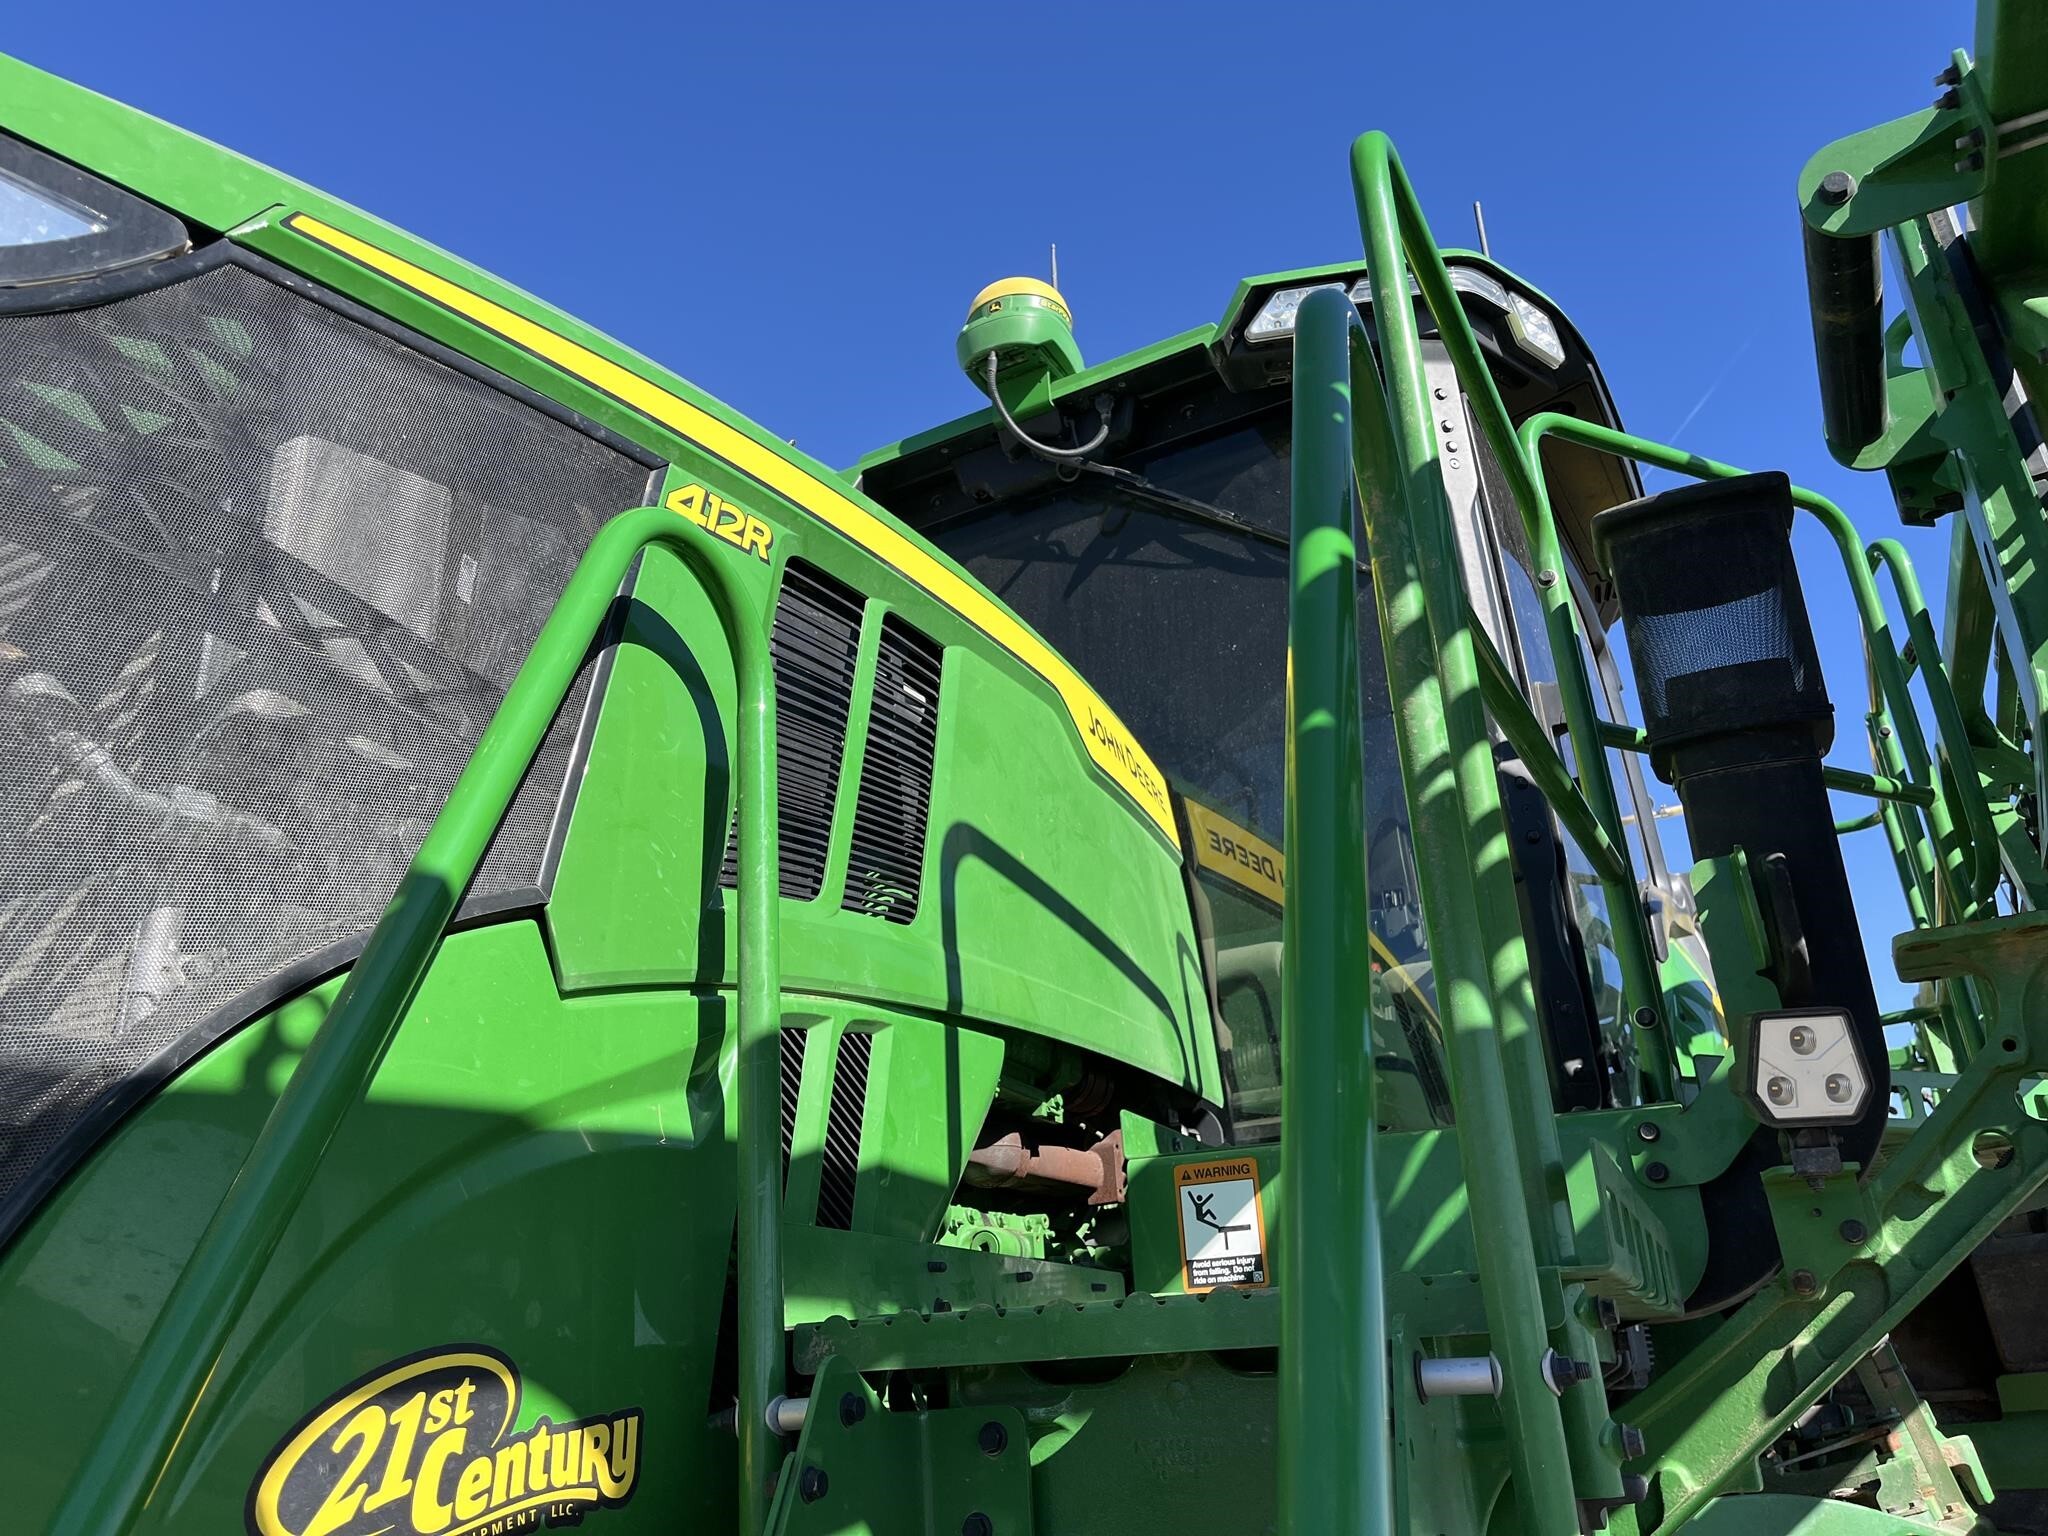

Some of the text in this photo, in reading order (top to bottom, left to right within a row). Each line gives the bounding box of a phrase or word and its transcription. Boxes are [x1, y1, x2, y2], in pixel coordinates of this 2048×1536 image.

[665, 483, 773, 566] 412R
[1088, 706, 1167, 815] JOHN DEERE
[1193, 1164, 1251, 1180] WARNING
[1192, 1256, 1256, 1269] Avoid serious injury
[1192, 1264, 1255, 1277] from falling. Do not
[1193, 1273, 1247, 1285] ride on machine.
[300, 1377, 476, 1536] 21st
